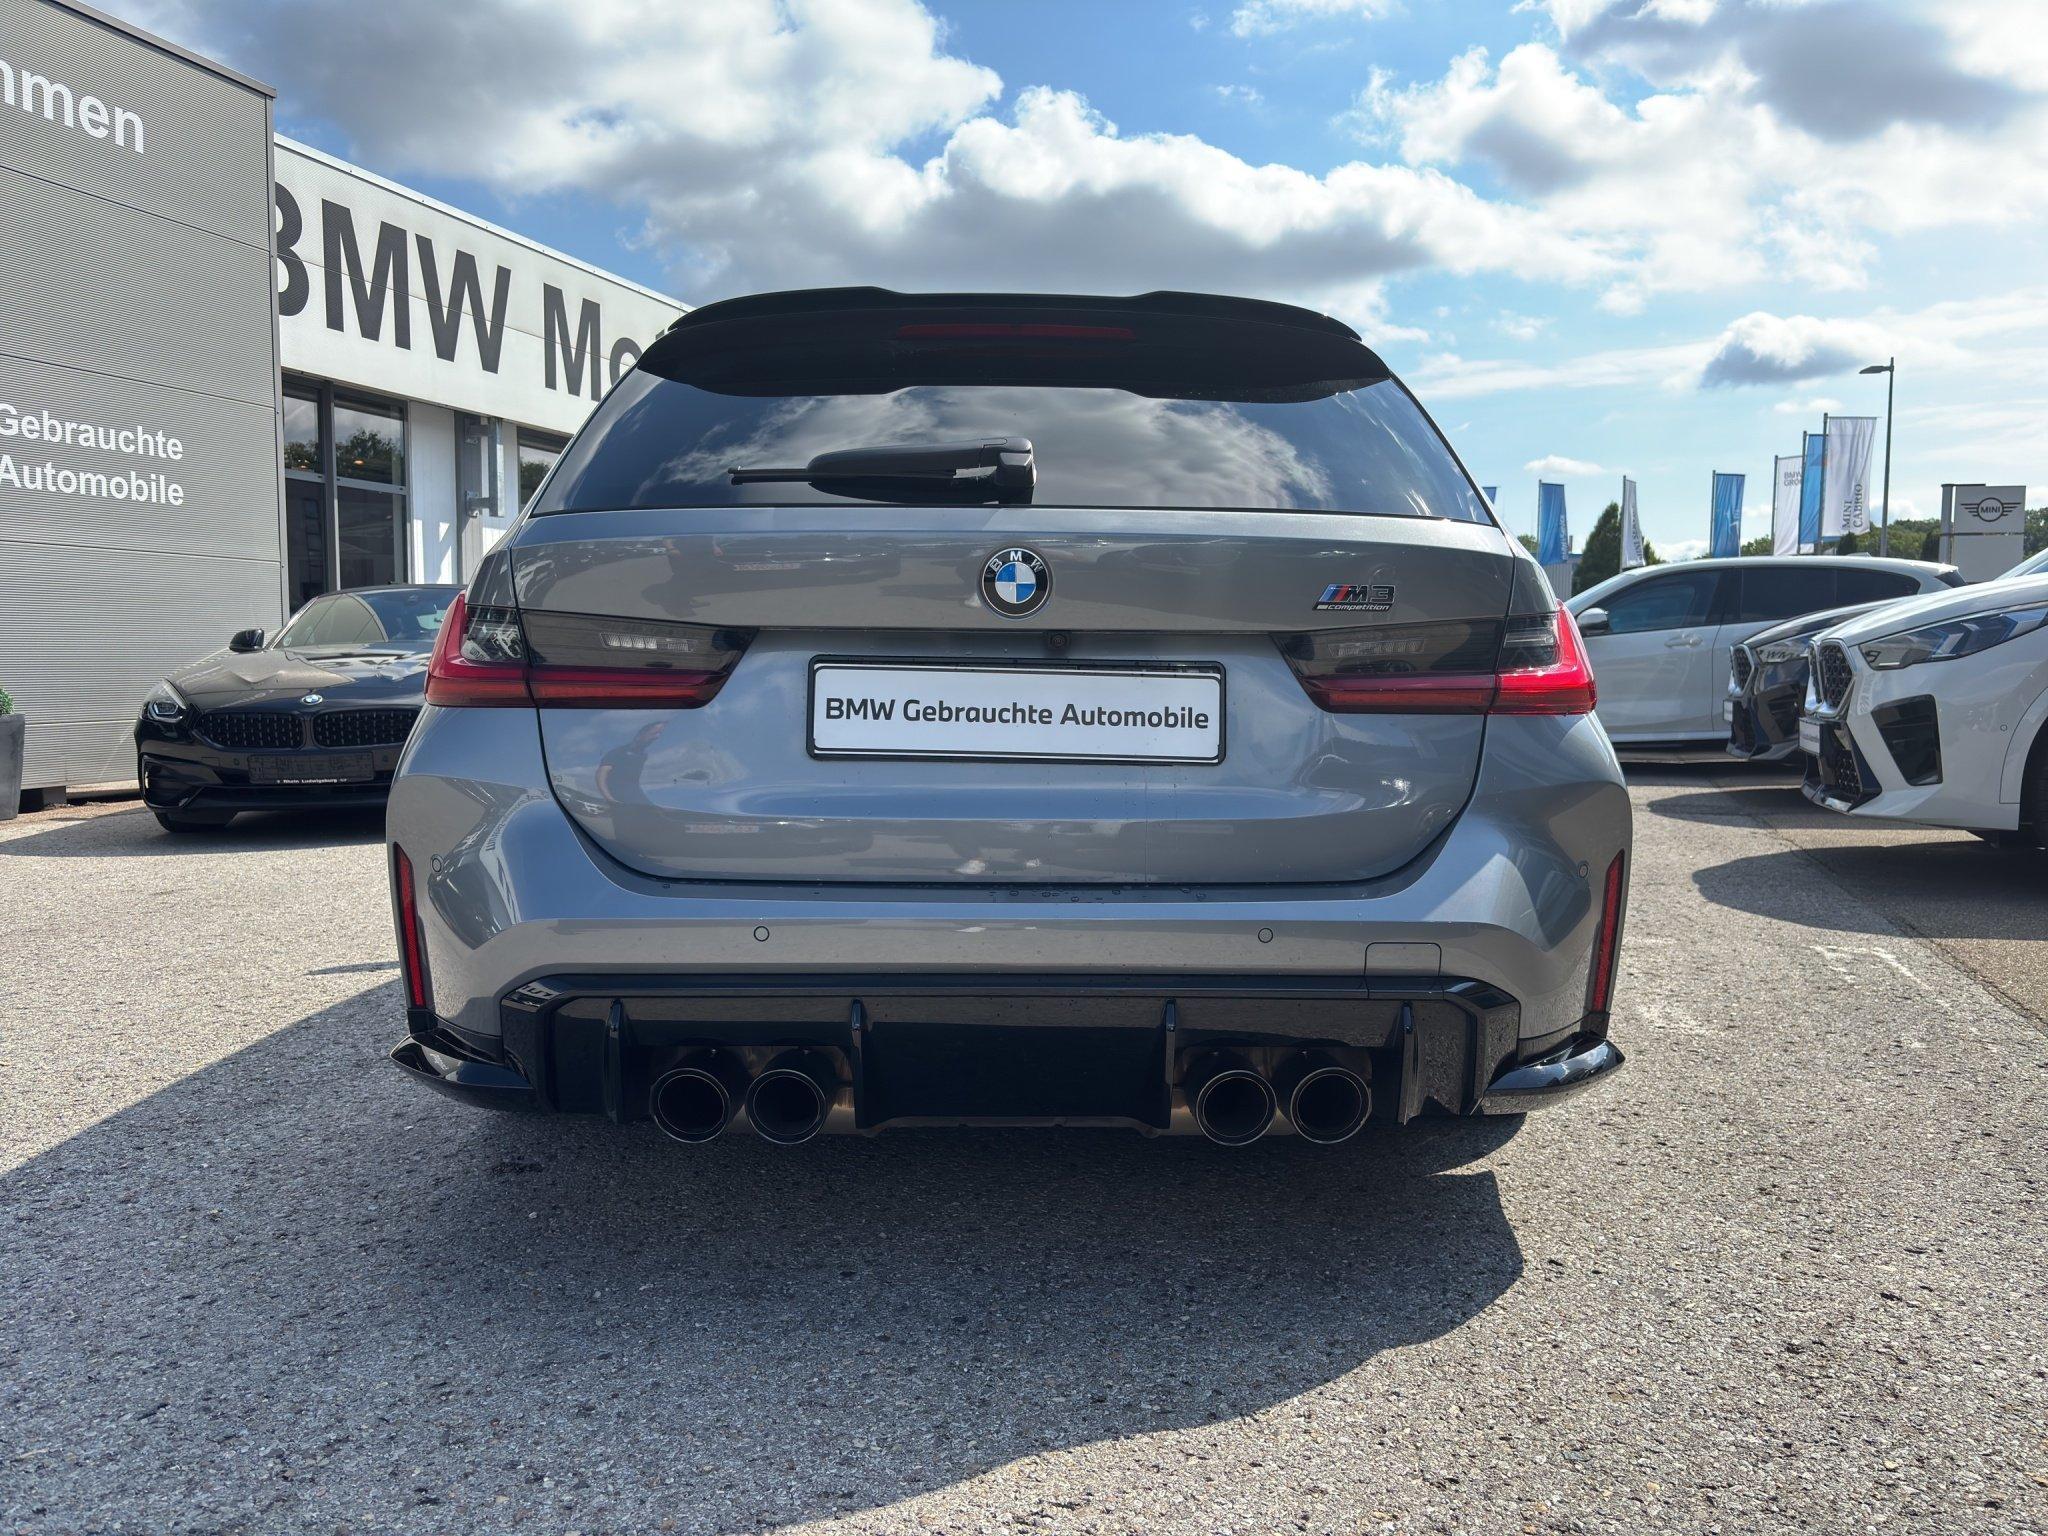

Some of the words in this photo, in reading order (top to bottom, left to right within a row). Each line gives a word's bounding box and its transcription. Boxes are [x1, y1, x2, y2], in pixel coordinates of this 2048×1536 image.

[0, 61, 144, 154] men
[543, 282, 664, 402] Mo
[0, 403, 183, 460] Gebrauchte
[0, 454, 184, 506] Automobile
[1784, 479, 1801, 487] GRO
[1842, 500, 1852, 531] MINI
[1853, 483, 1863, 528] CABRIO
[1980, 506, 2001, 514] MINI
[989, 551, 1044, 573] BMW
[1338, 584, 1395, 604] M3
[826, 697, 895, 721] BMW
[902, 699, 1053, 725] Gebrauchte
[1060, 703, 1209, 729] Automobile
